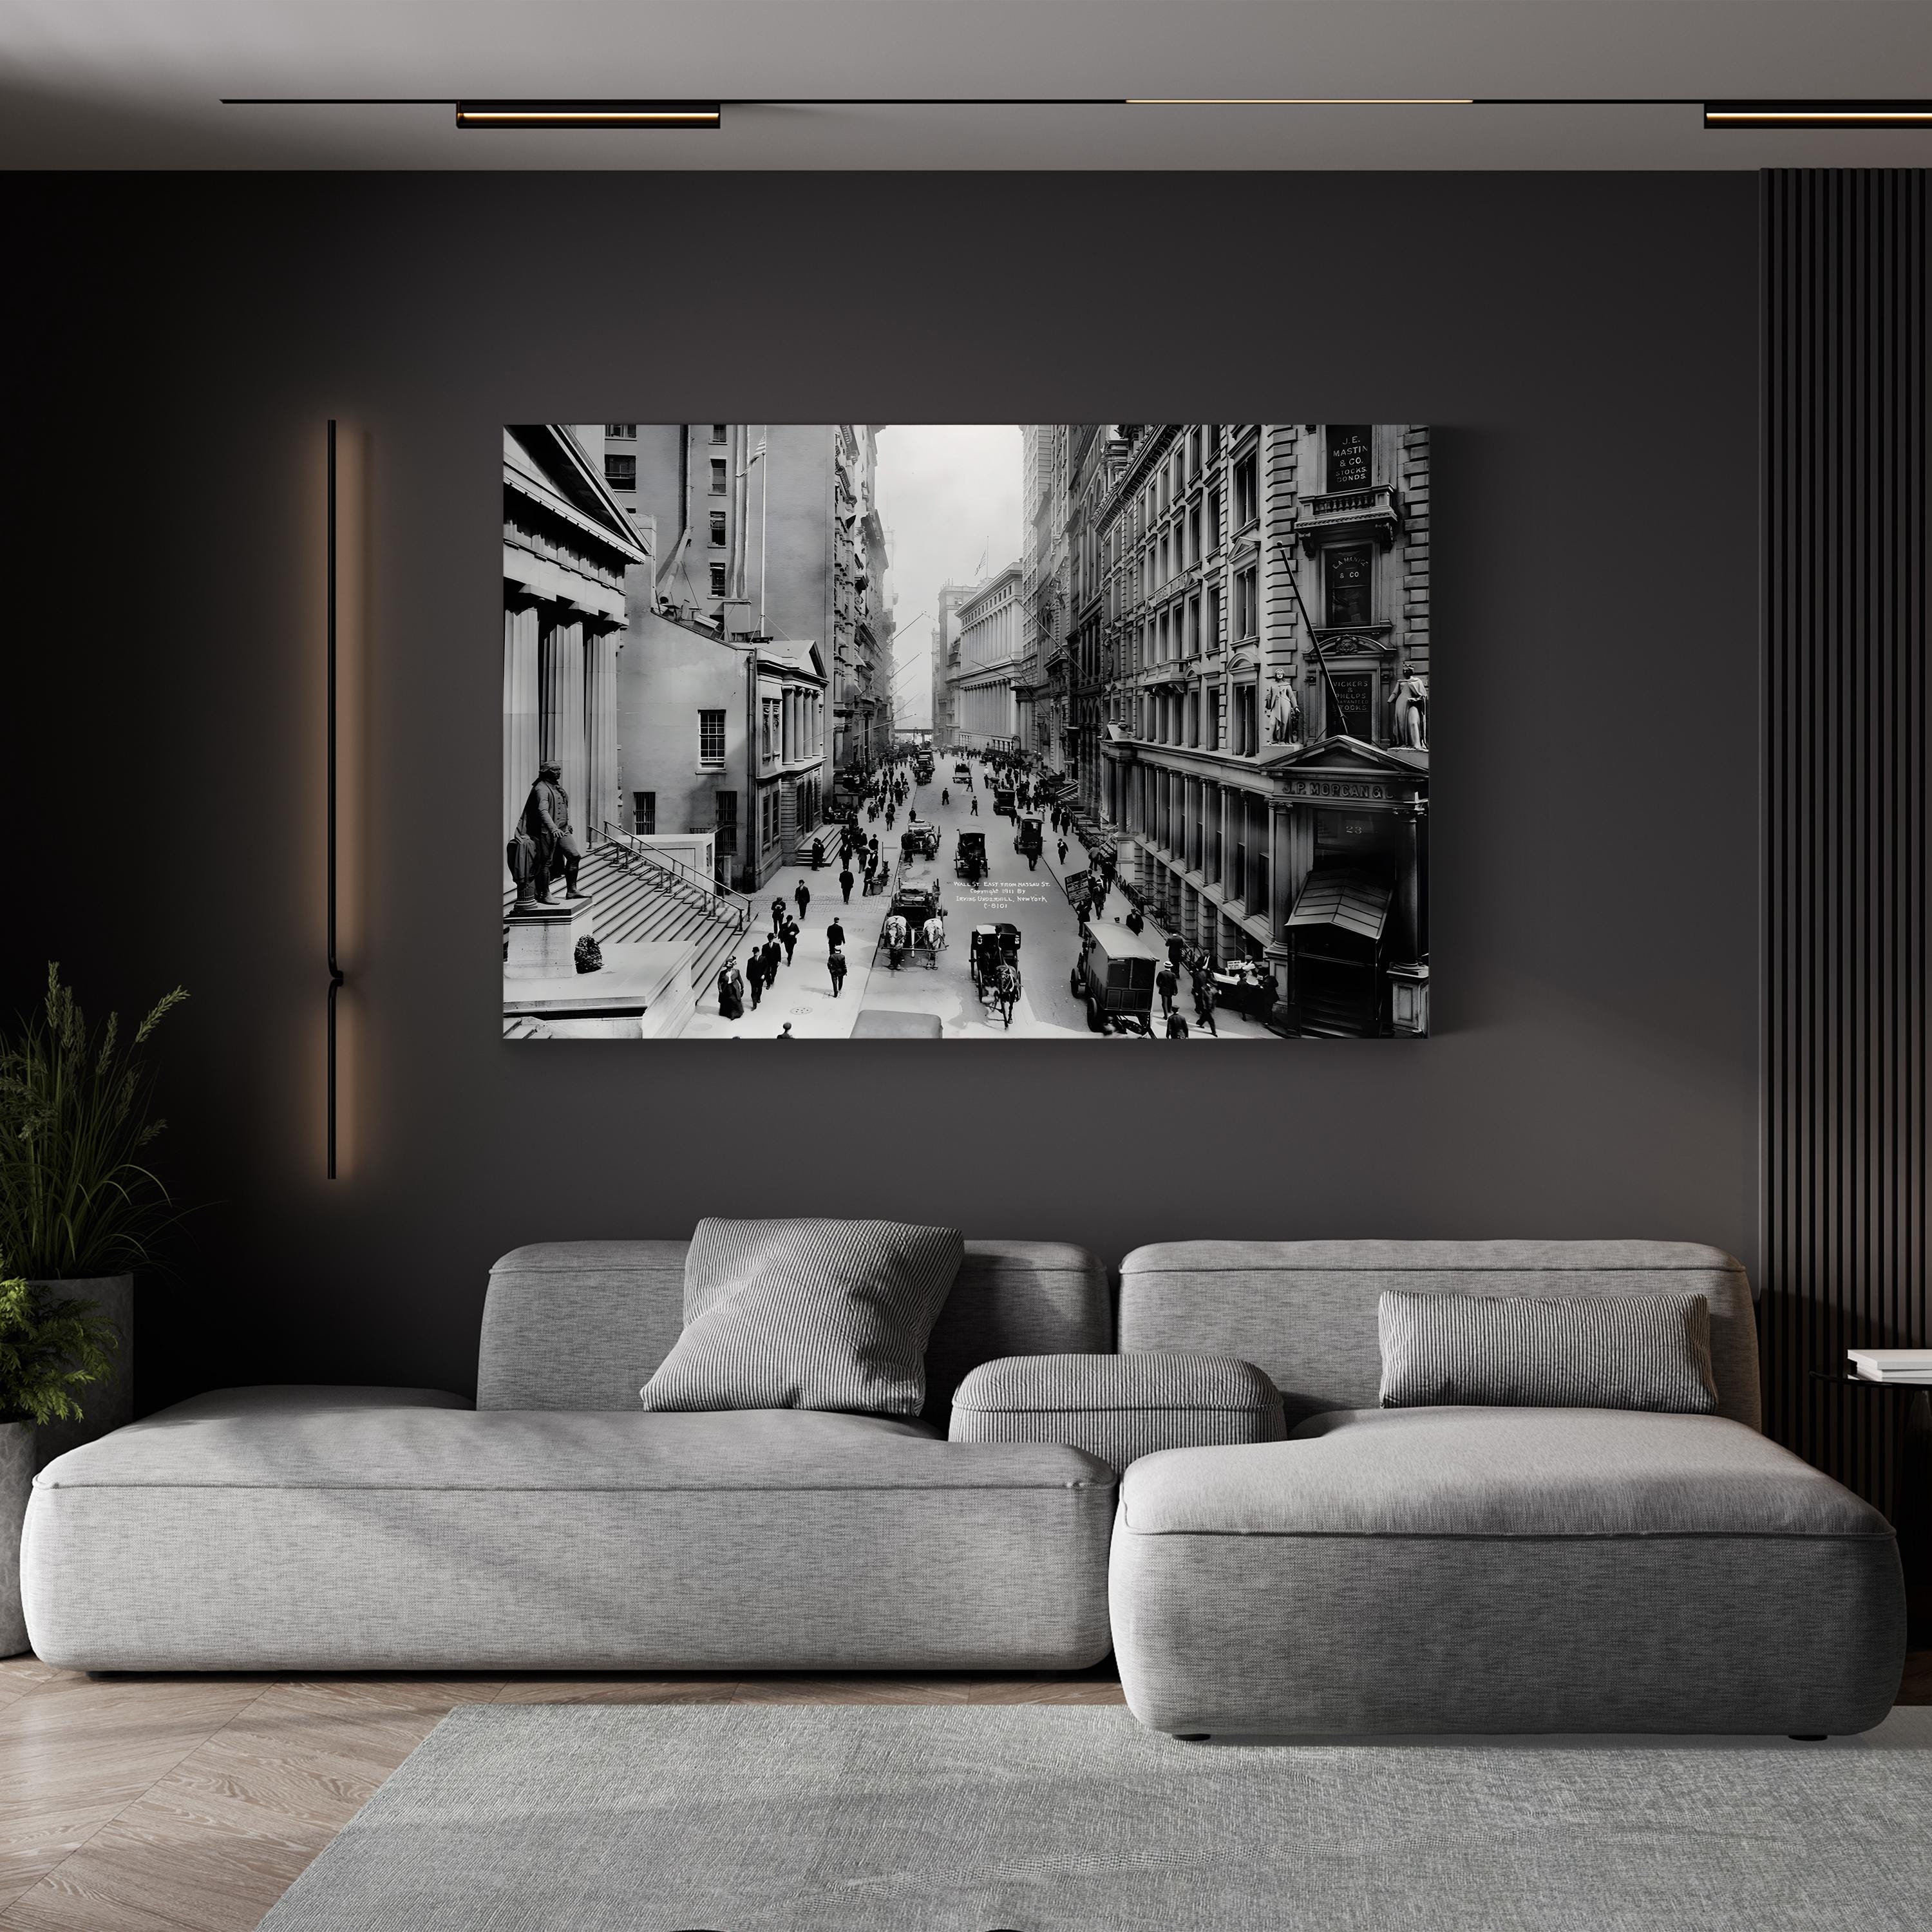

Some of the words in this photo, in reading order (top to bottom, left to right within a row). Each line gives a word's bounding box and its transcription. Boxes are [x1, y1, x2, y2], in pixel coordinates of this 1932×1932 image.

[1333, 446, 1368, 457] MASTIN
[1349, 457, 1363, 465] CO.
[1372, 786, 1381, 799] &
